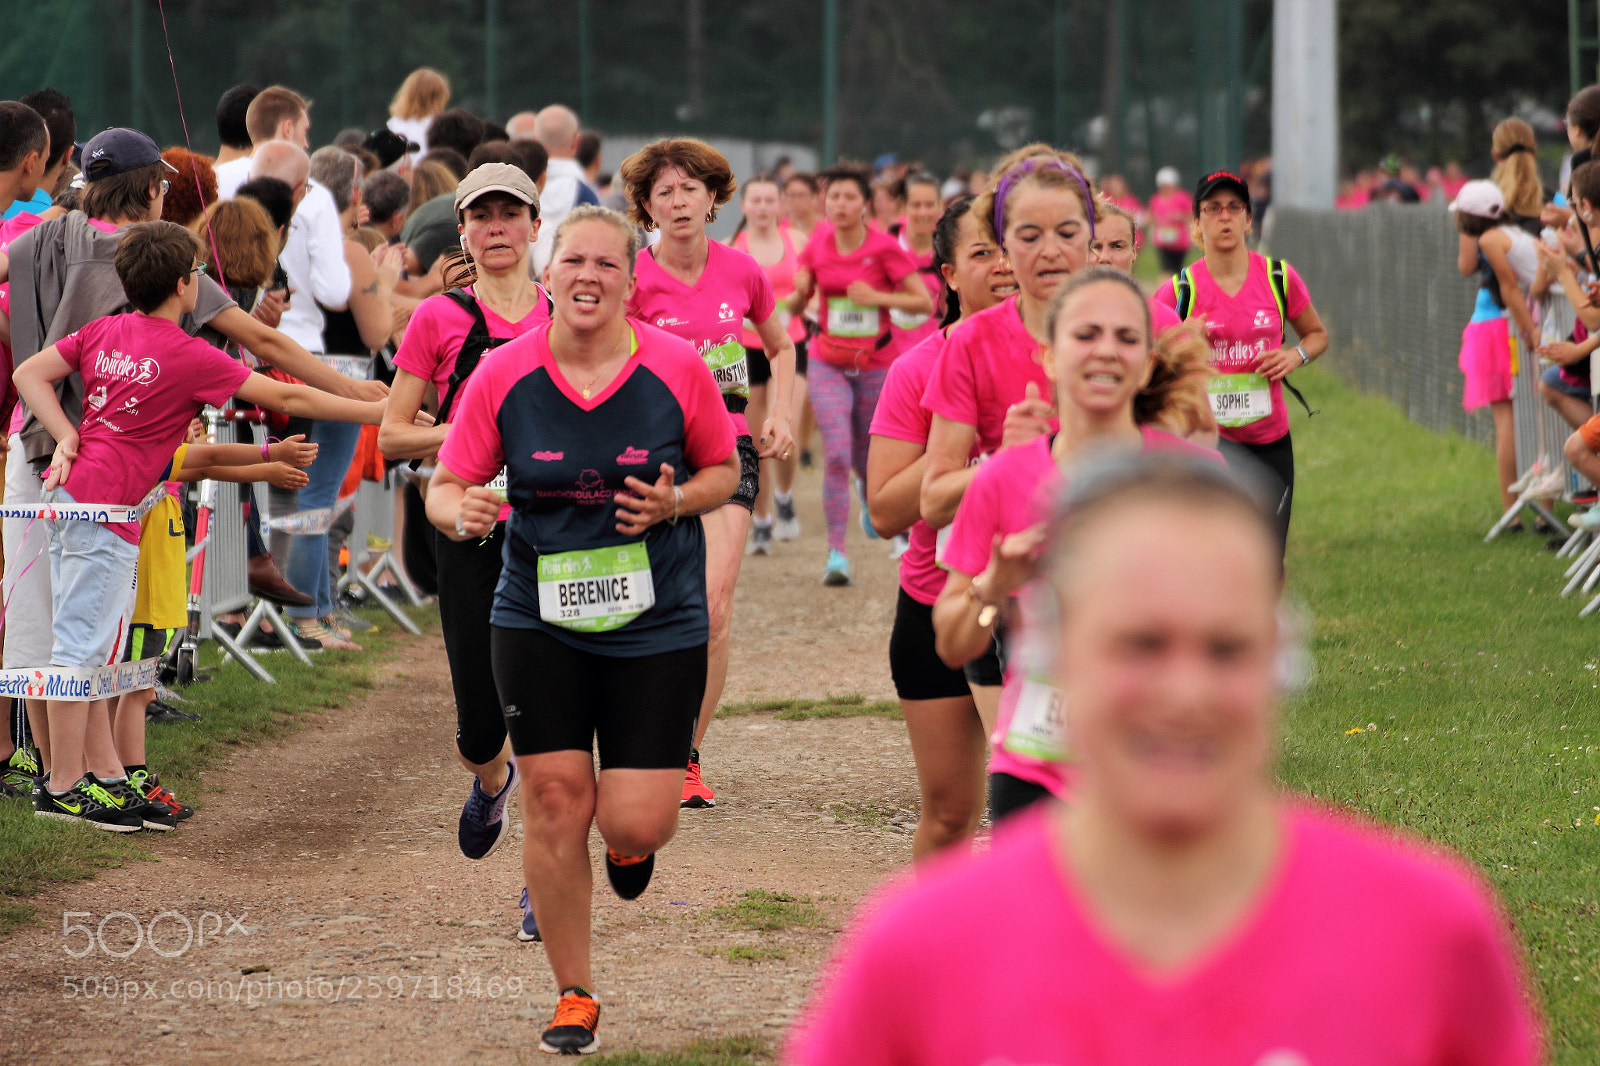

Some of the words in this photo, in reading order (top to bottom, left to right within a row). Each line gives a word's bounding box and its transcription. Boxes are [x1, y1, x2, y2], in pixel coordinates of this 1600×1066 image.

[1216, 393, 1250, 410] SOPHIE
[558, 577, 630, 607] BERENICE
[559, 608, 581, 619] 328
